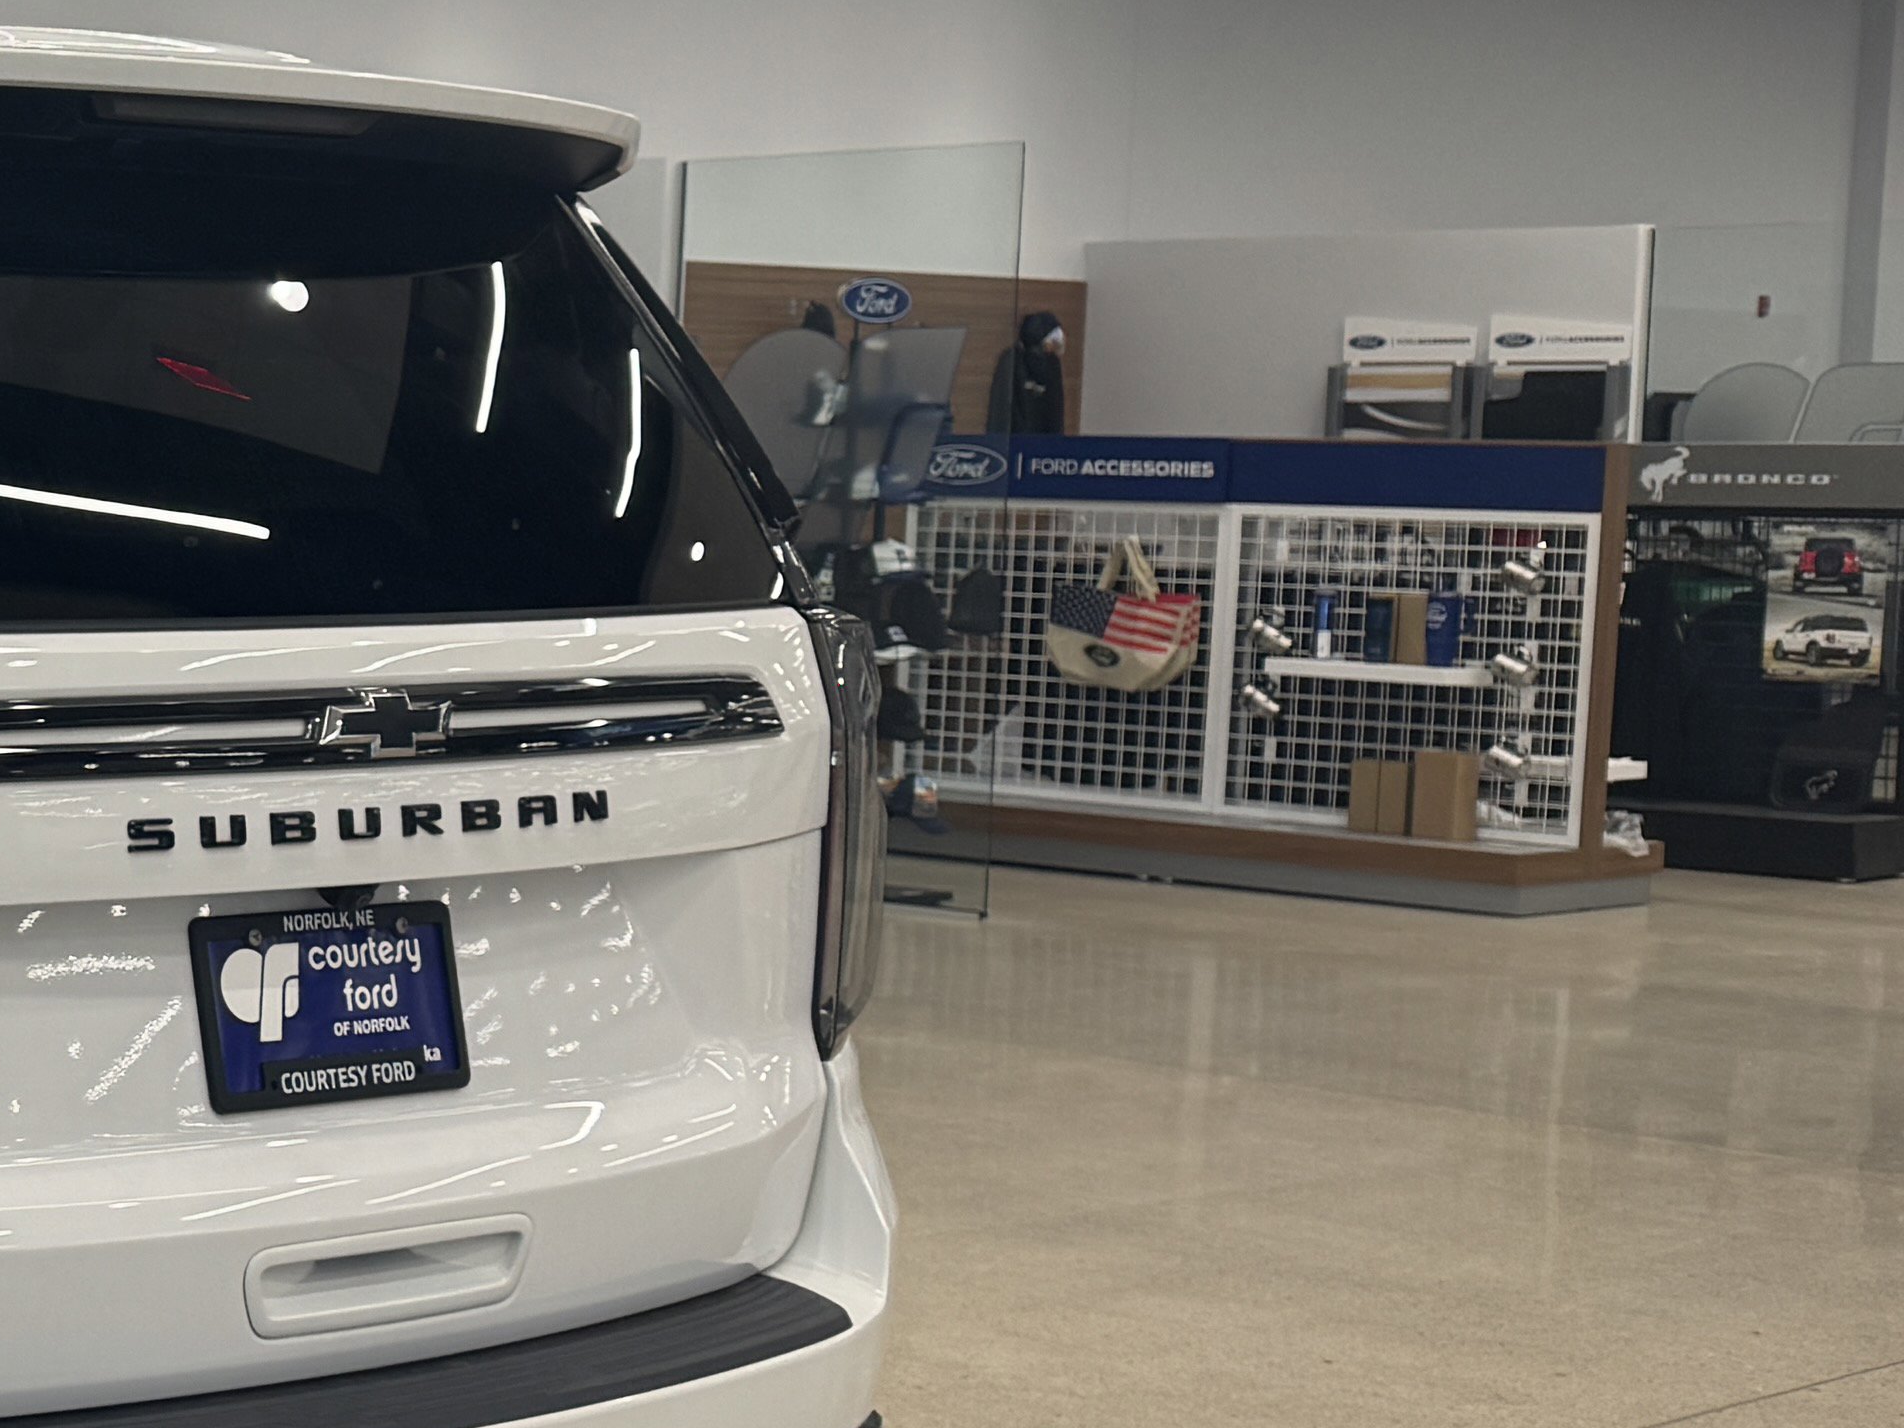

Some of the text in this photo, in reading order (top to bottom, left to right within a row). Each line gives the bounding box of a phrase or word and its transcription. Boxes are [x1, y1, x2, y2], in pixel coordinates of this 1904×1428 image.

[1031, 457, 1215, 479] FORD ACCESSORIES
[1688, 473, 1832, 485] BRONCO
[126, 789, 610, 854] SUBURBAN
[356, 909, 375, 925] NE
[308, 937, 421, 973] courtesy
[343, 973, 398, 1012] ford
[333, 1015, 411, 1037] OF NORFOLK
[281, 1060, 417, 1095] COURTESY FORD
